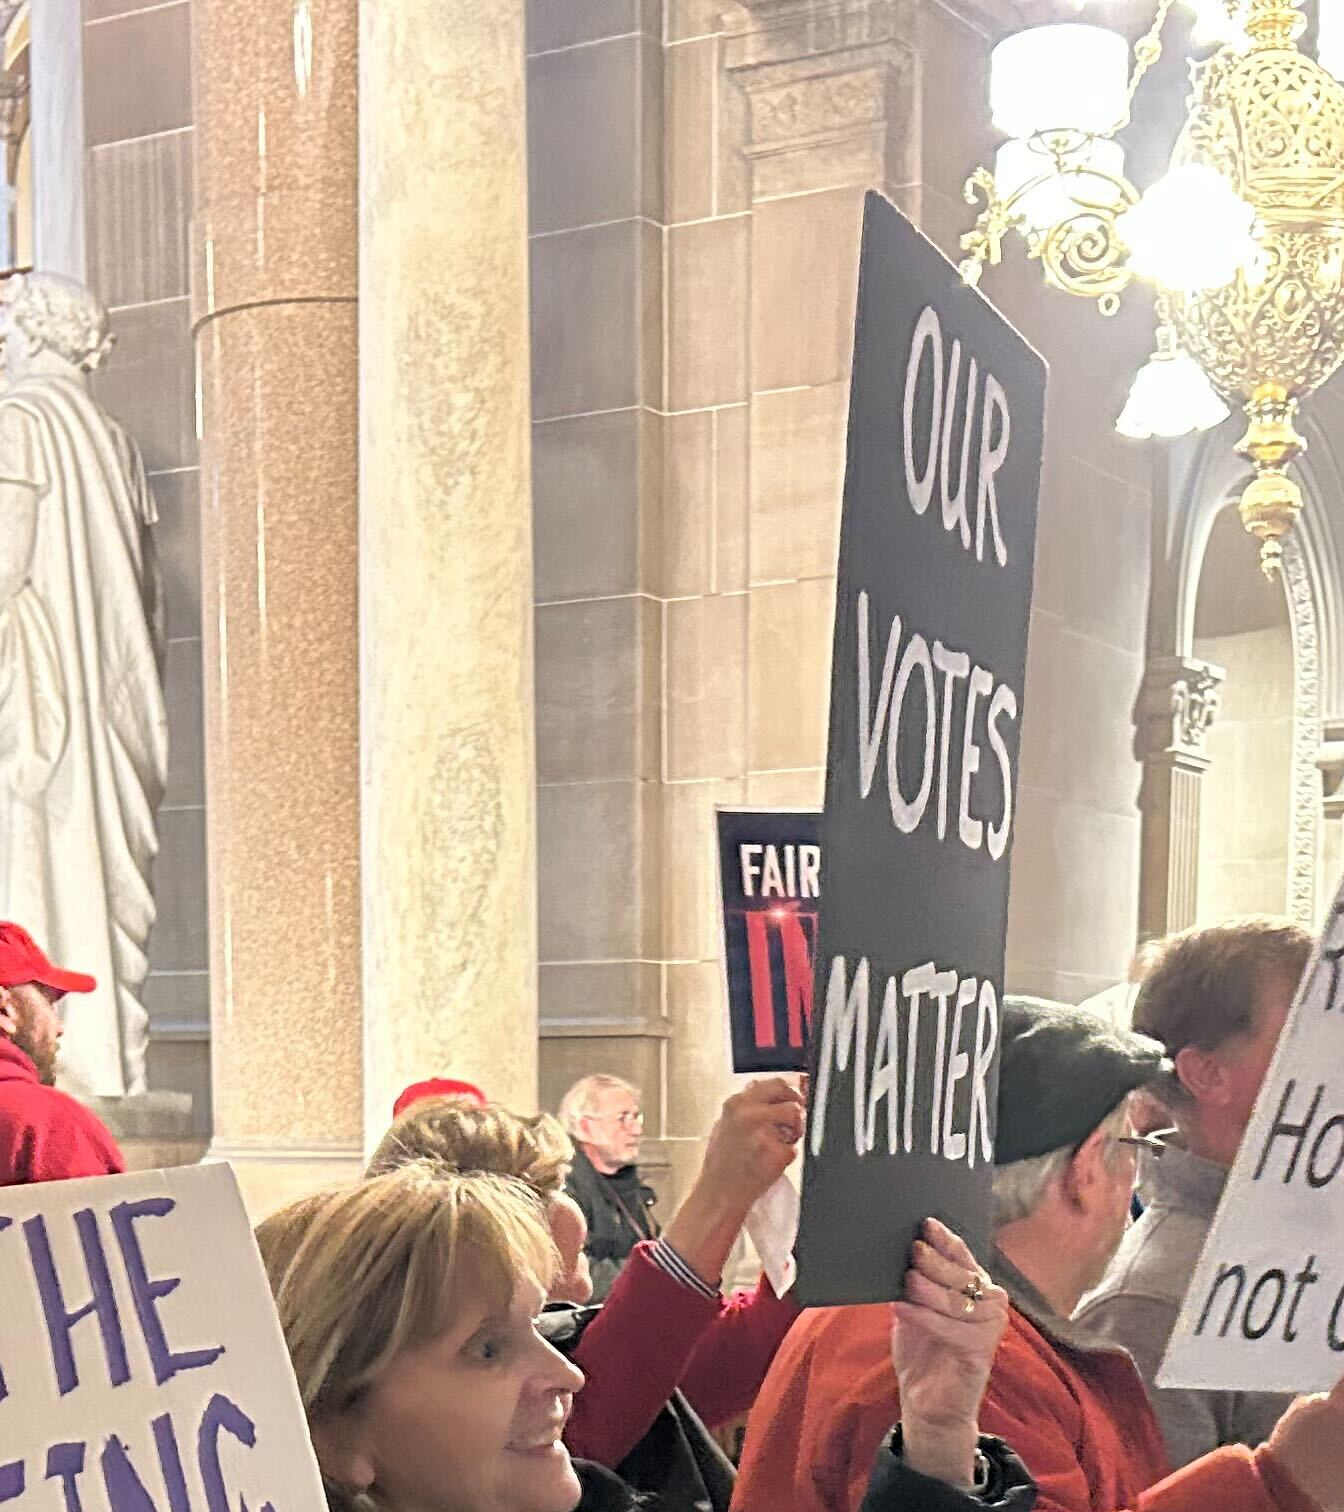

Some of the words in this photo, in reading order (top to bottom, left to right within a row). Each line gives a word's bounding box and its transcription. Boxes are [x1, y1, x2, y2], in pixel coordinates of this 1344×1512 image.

[902, 305, 1009, 568] OUR
[857, 591, 1017, 862] VOTES
[739, 843, 822, 898] FAIR
[809, 954, 996, 1166] MATTER
[1194, 1256, 1317, 1342] not
